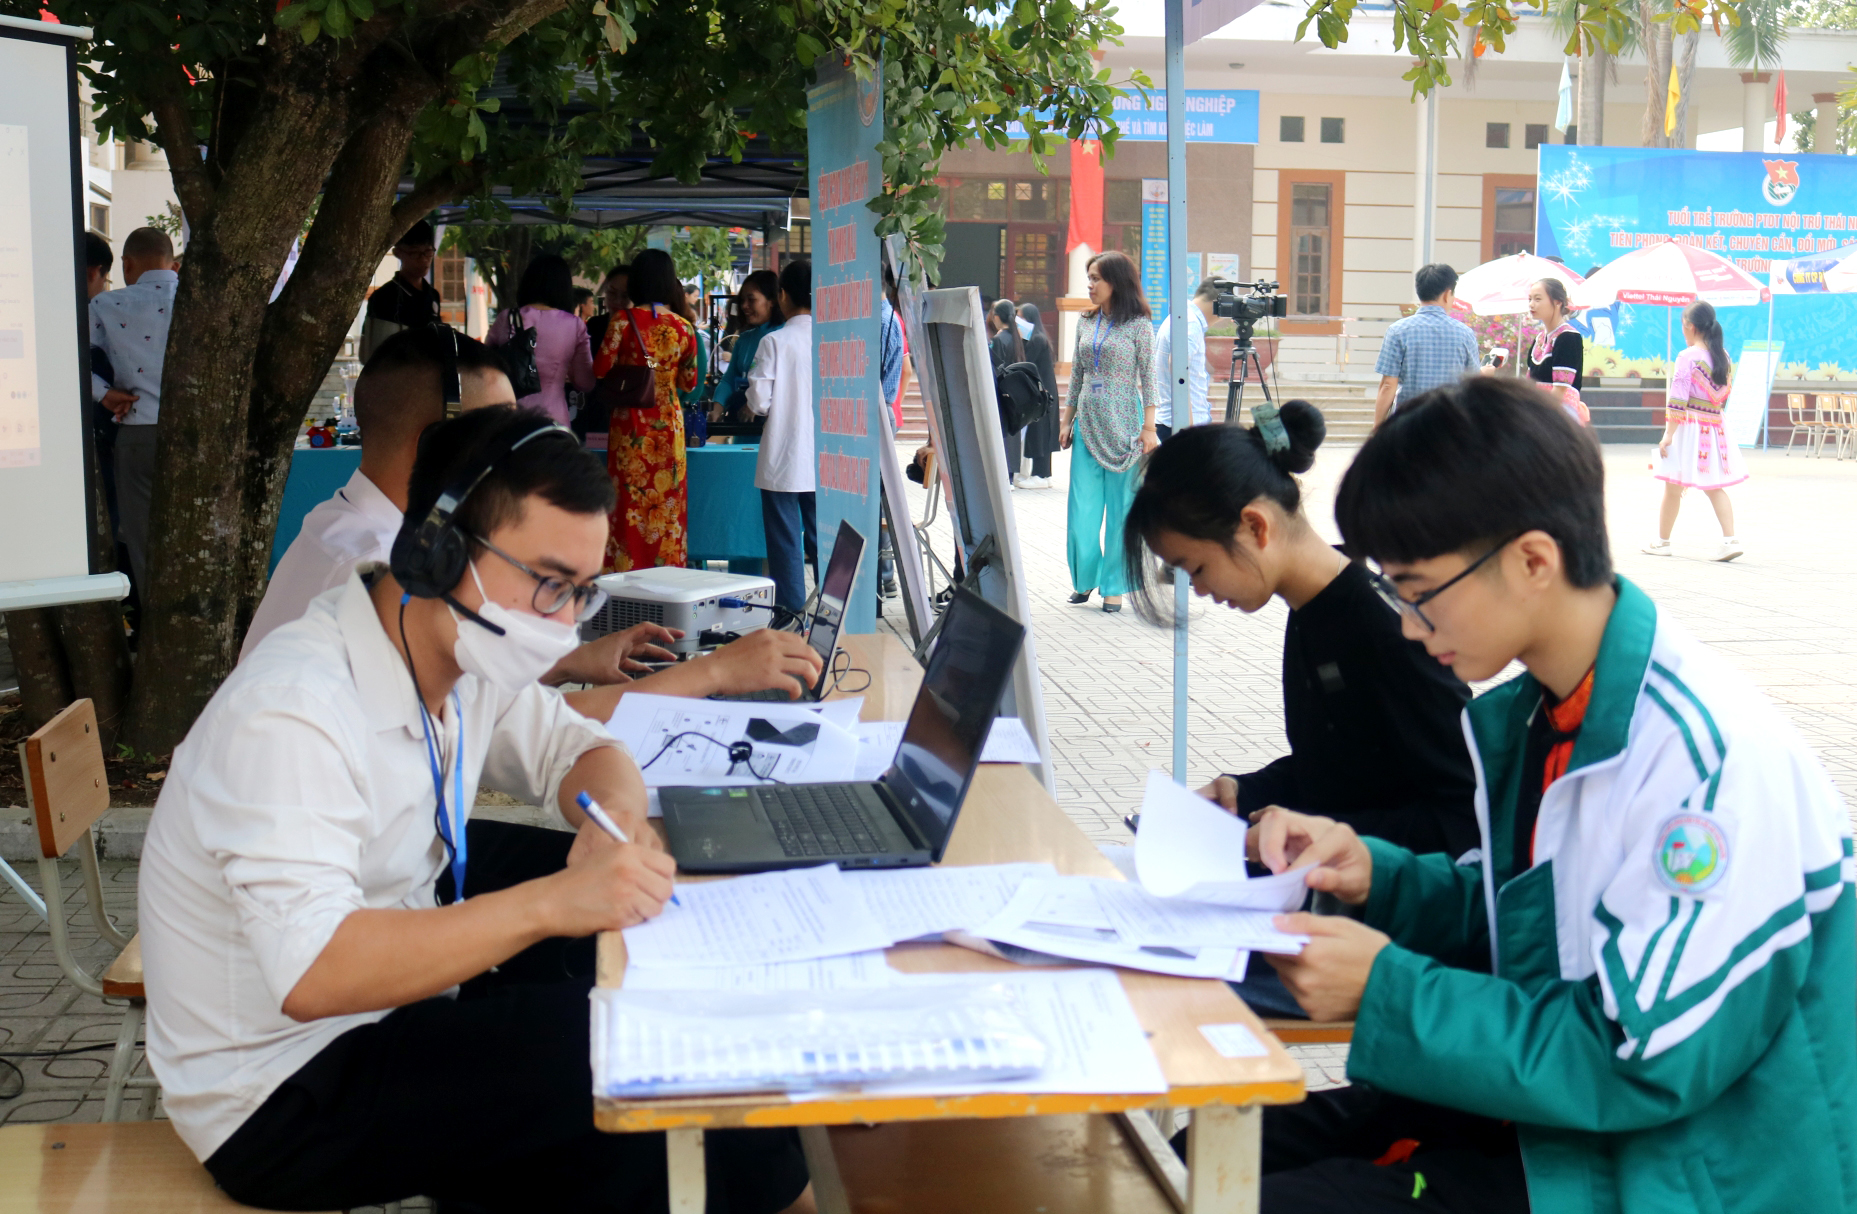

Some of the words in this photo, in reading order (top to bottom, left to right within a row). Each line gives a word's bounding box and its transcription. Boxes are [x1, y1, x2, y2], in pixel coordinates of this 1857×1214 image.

[1185, 94, 1236, 117] NGHIỆP
[1197, 120, 1214, 136] LÀM
[1667, 206, 1691, 226] TUỔI
[1693, 206, 1712, 227] TRẺ
[1714, 209, 1754, 228] TRƯỜNG
[1755, 213, 1781, 228] PTDT
[1782, 211, 1800, 232] NỘI
[1802, 212, 1822, 229] TRÚ
[1823, 212, 1846, 230] THÁI
[1609, 229, 1633, 248] TIÊN
[1705, 230, 1727, 252] KẾT,
[1729, 234, 1769, 251] CHUYÊN
[1797, 232, 1815, 252] ĐỔI
[1622, 291, 1645, 300] Viettel
[1646, 293, 1661, 301] Thái
[1662, 294, 1691, 304] Nguyên
